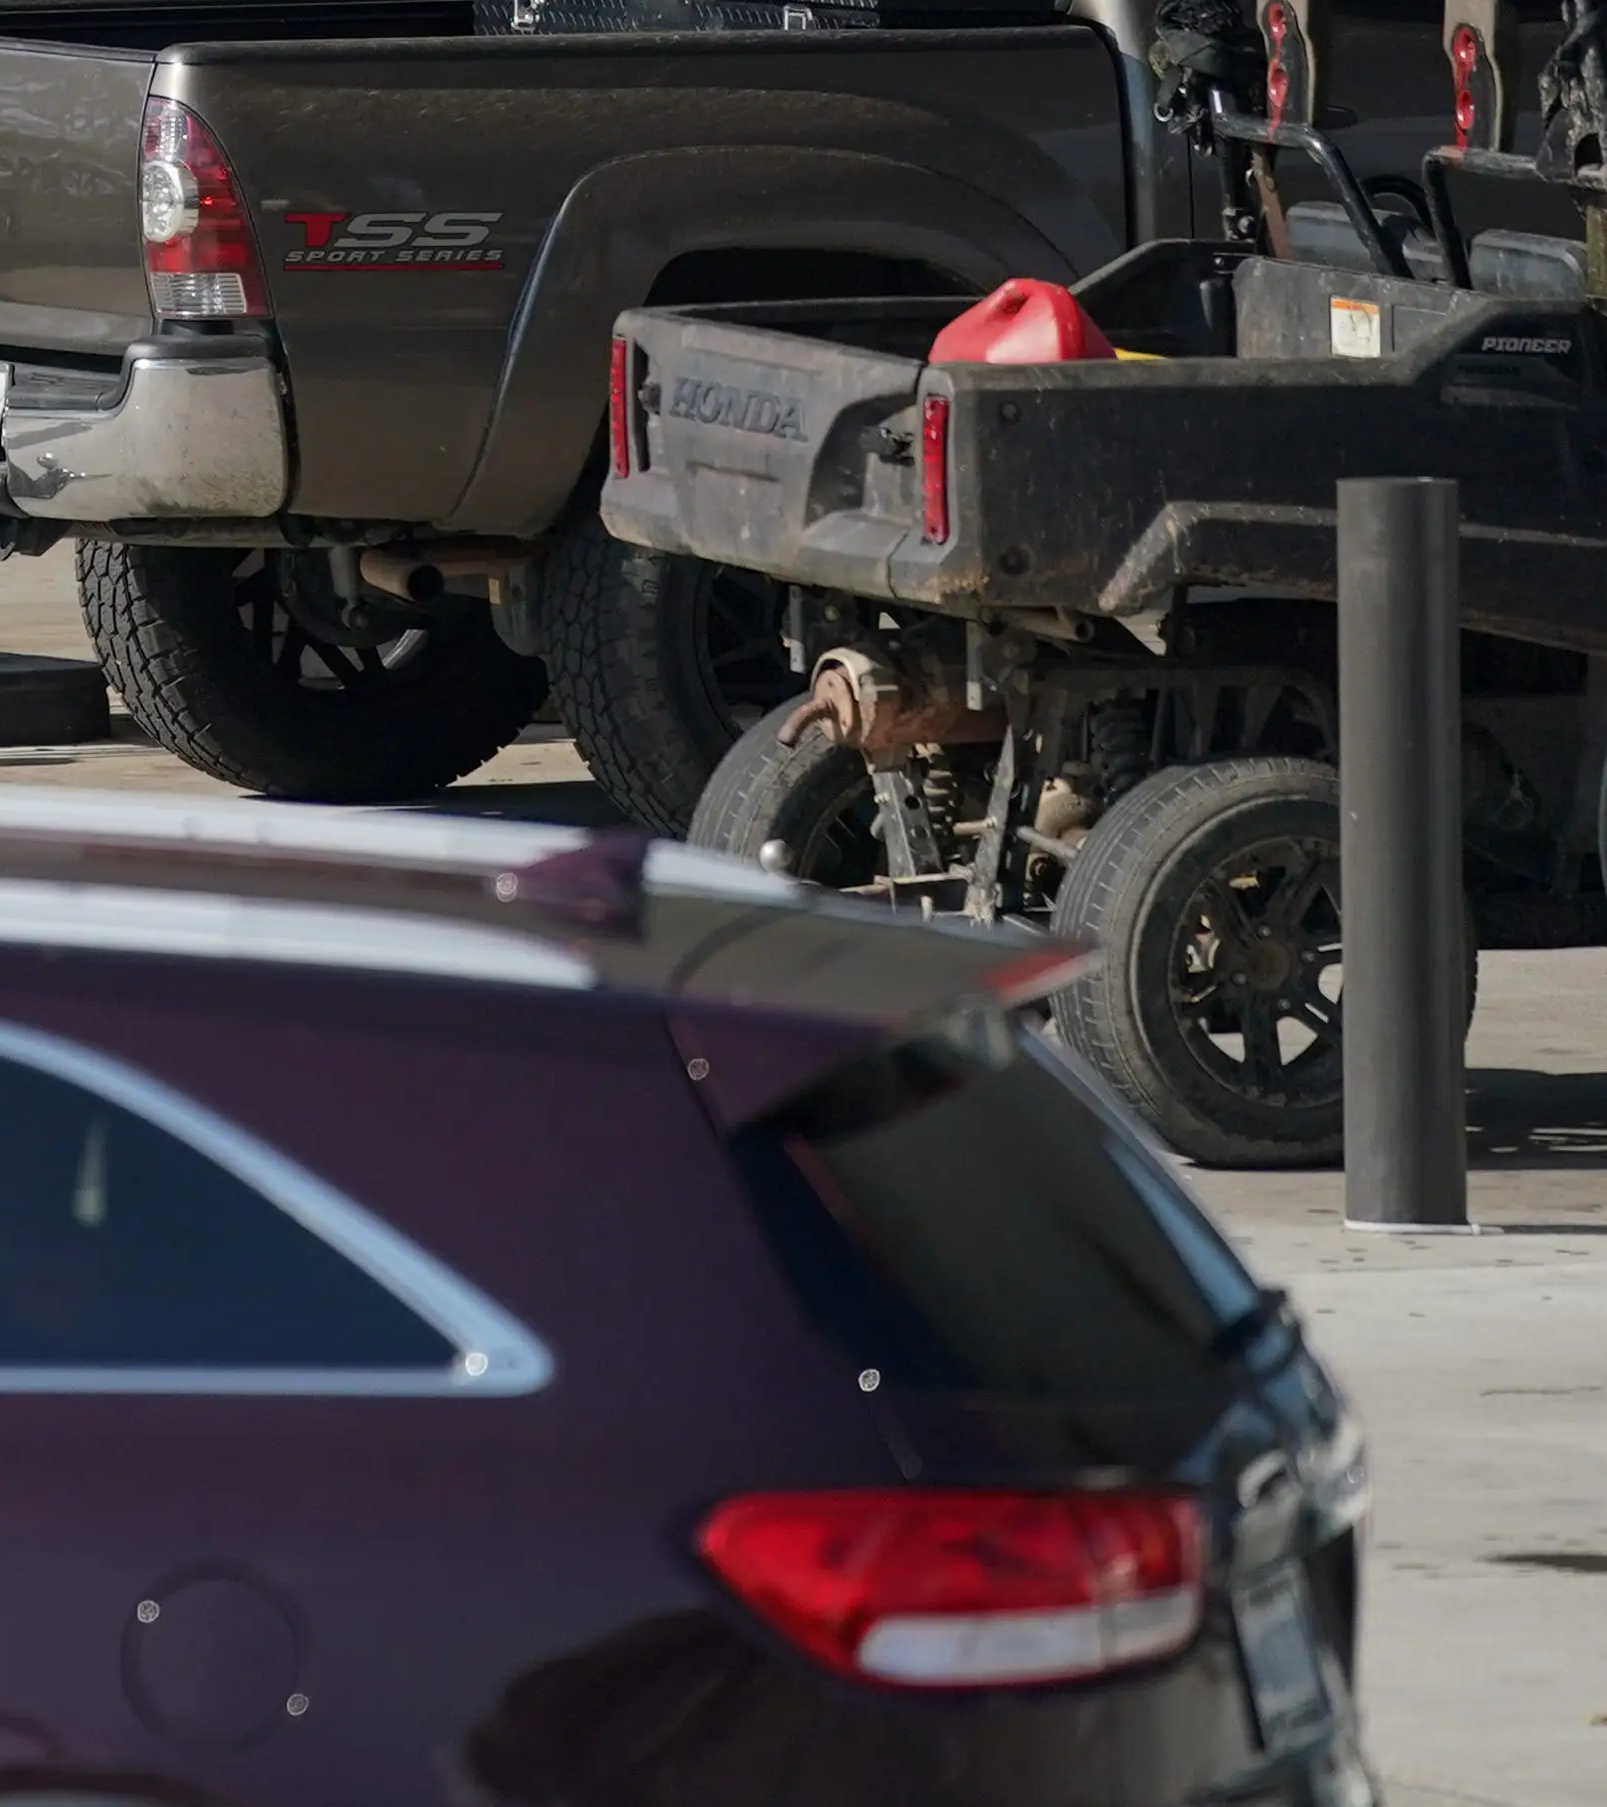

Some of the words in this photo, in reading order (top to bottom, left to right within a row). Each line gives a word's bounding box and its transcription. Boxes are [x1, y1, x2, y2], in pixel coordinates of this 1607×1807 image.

[284, 211, 504, 248] TSS
[285, 249, 386, 262] SPORT
[395, 248, 504, 262] SERIES
[1481, 335, 1574, 355] PIONEER
[668, 375, 809, 443] HONDA
